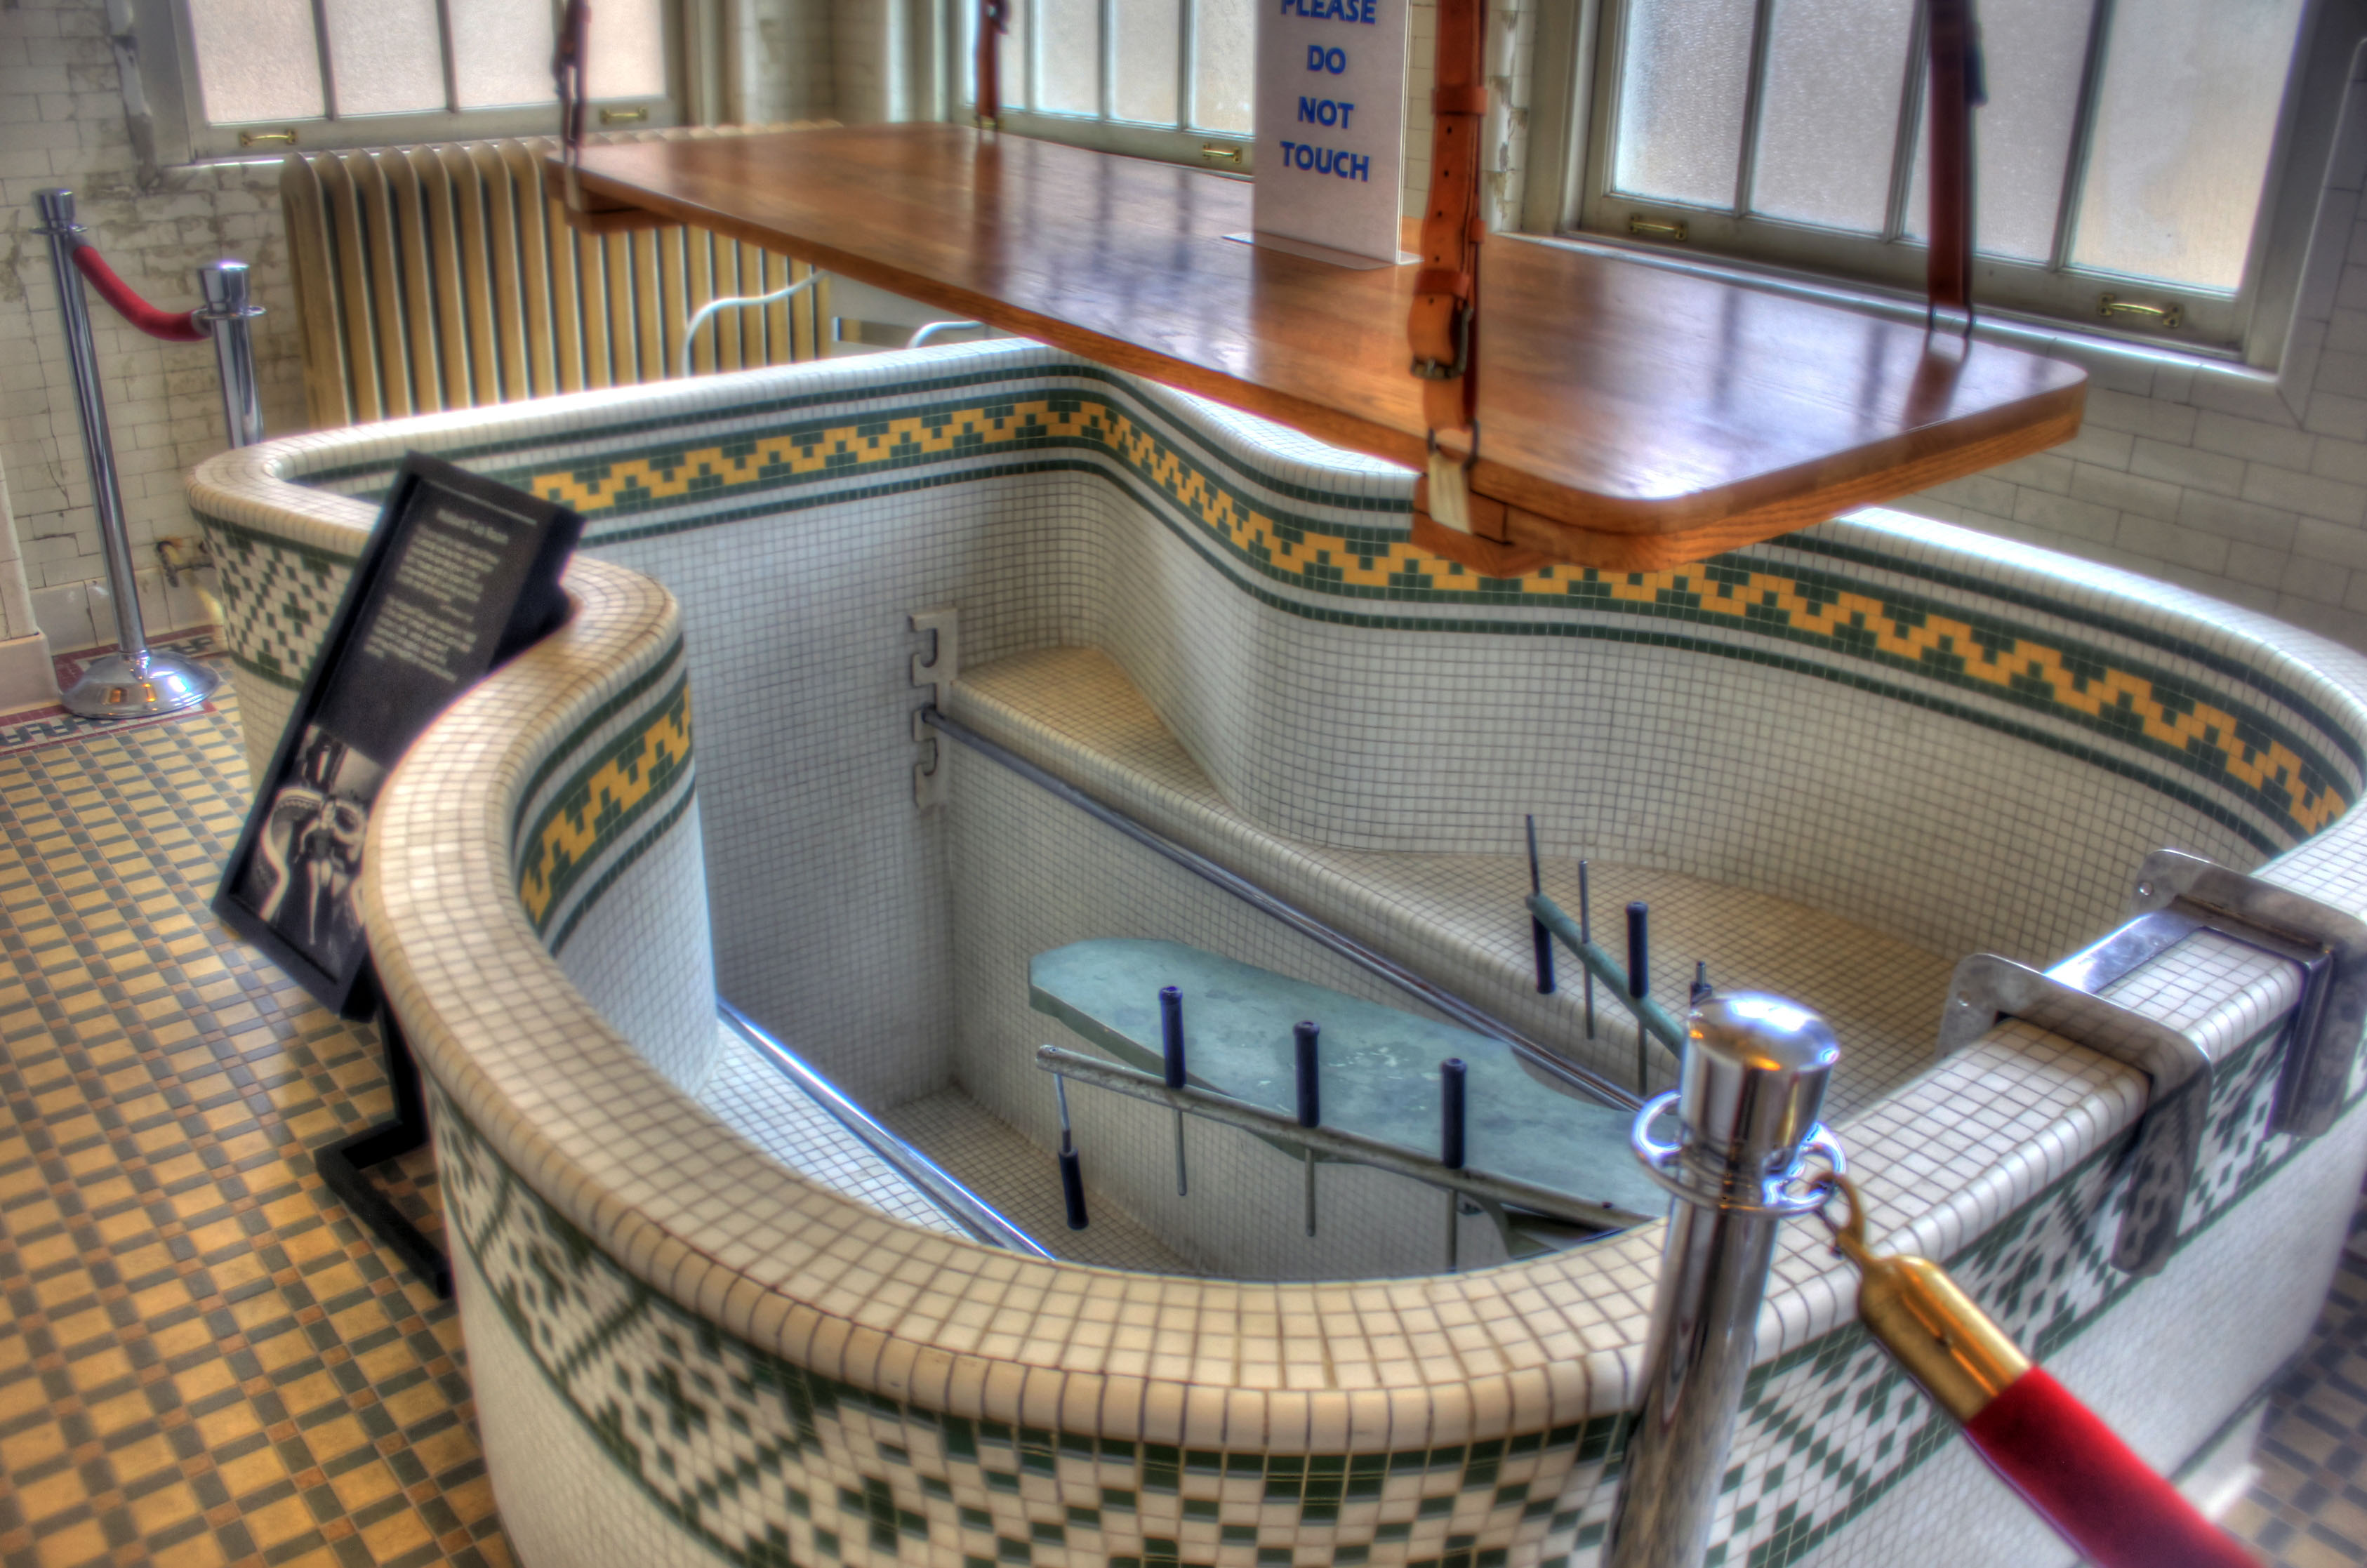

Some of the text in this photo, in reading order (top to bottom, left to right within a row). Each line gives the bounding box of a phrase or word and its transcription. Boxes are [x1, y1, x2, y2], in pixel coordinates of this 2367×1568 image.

[1280, 0, 1377, 24] PLEASE
[1307, 45, 1346, 74] DO
[1298, 96, 1355, 129] NOT
[1280, 141, 1370, 182] TOUCH
